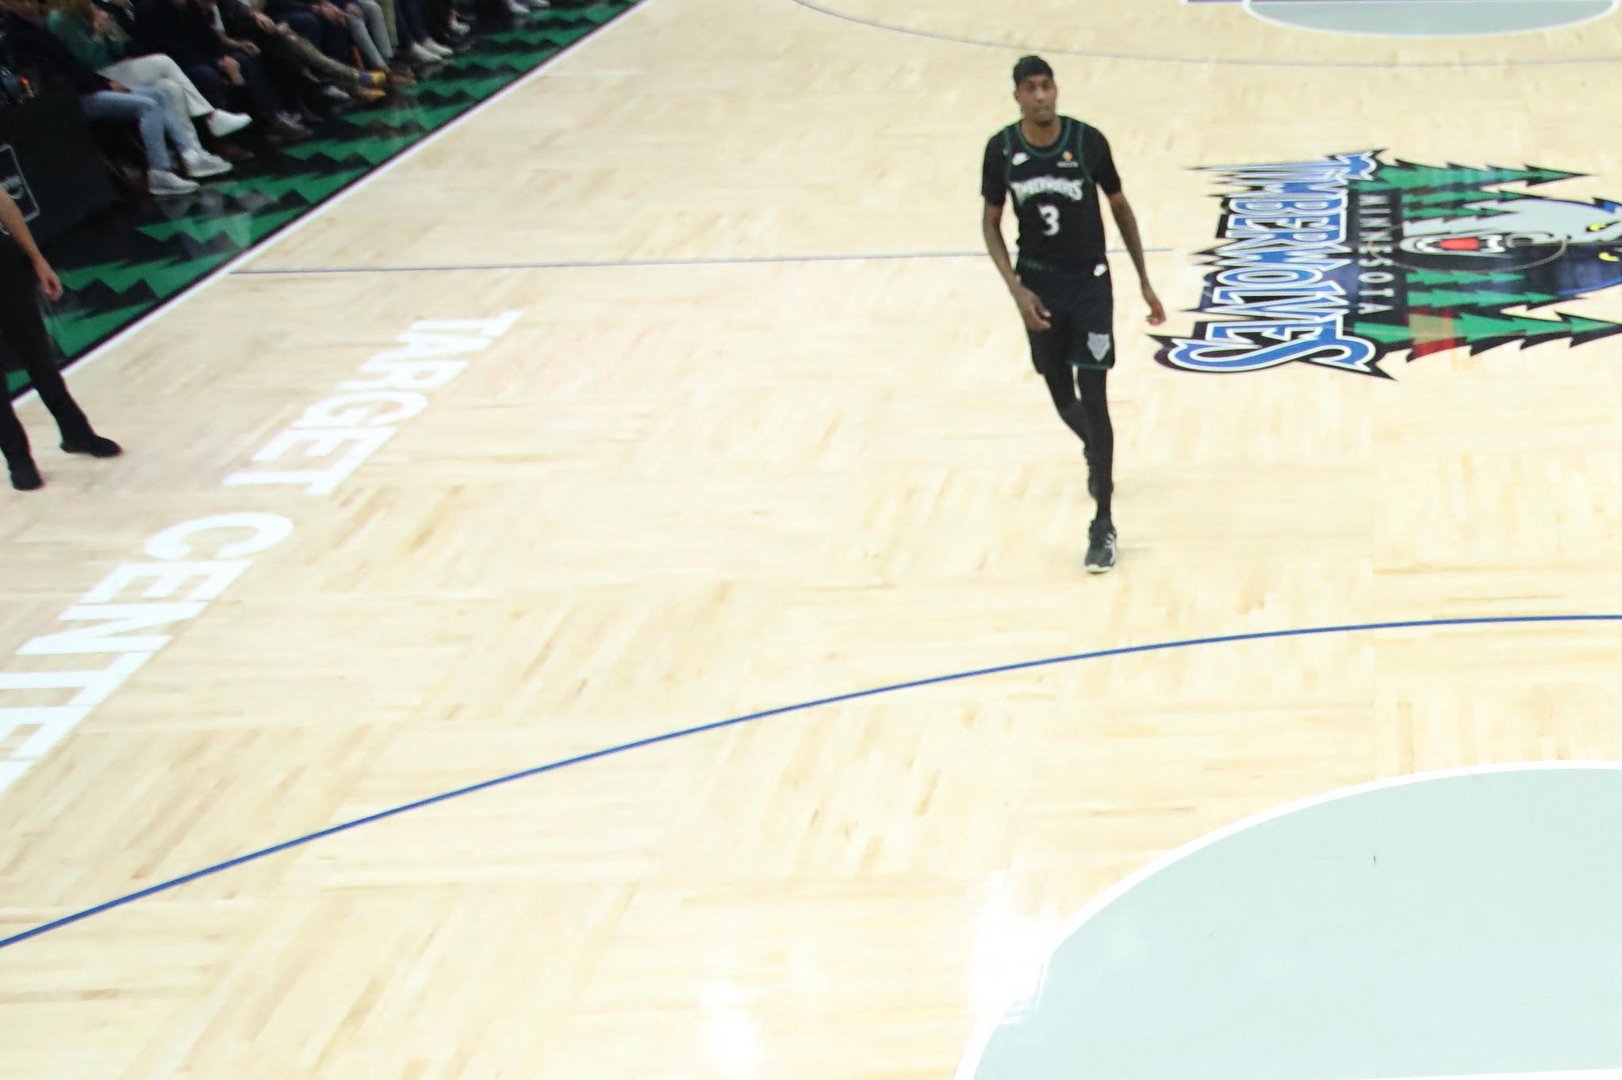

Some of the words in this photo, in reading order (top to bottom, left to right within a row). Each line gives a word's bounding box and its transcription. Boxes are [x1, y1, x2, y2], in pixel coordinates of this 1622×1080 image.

[1039, 204, 1060, 236] 3
[1160, 150, 1385, 374] TIMBERWOLVES
[1358, 194, 1395, 315] MINNESOTA
[222, 310, 524, 496] TARGET
[0, 512, 294, 792] CENTE
